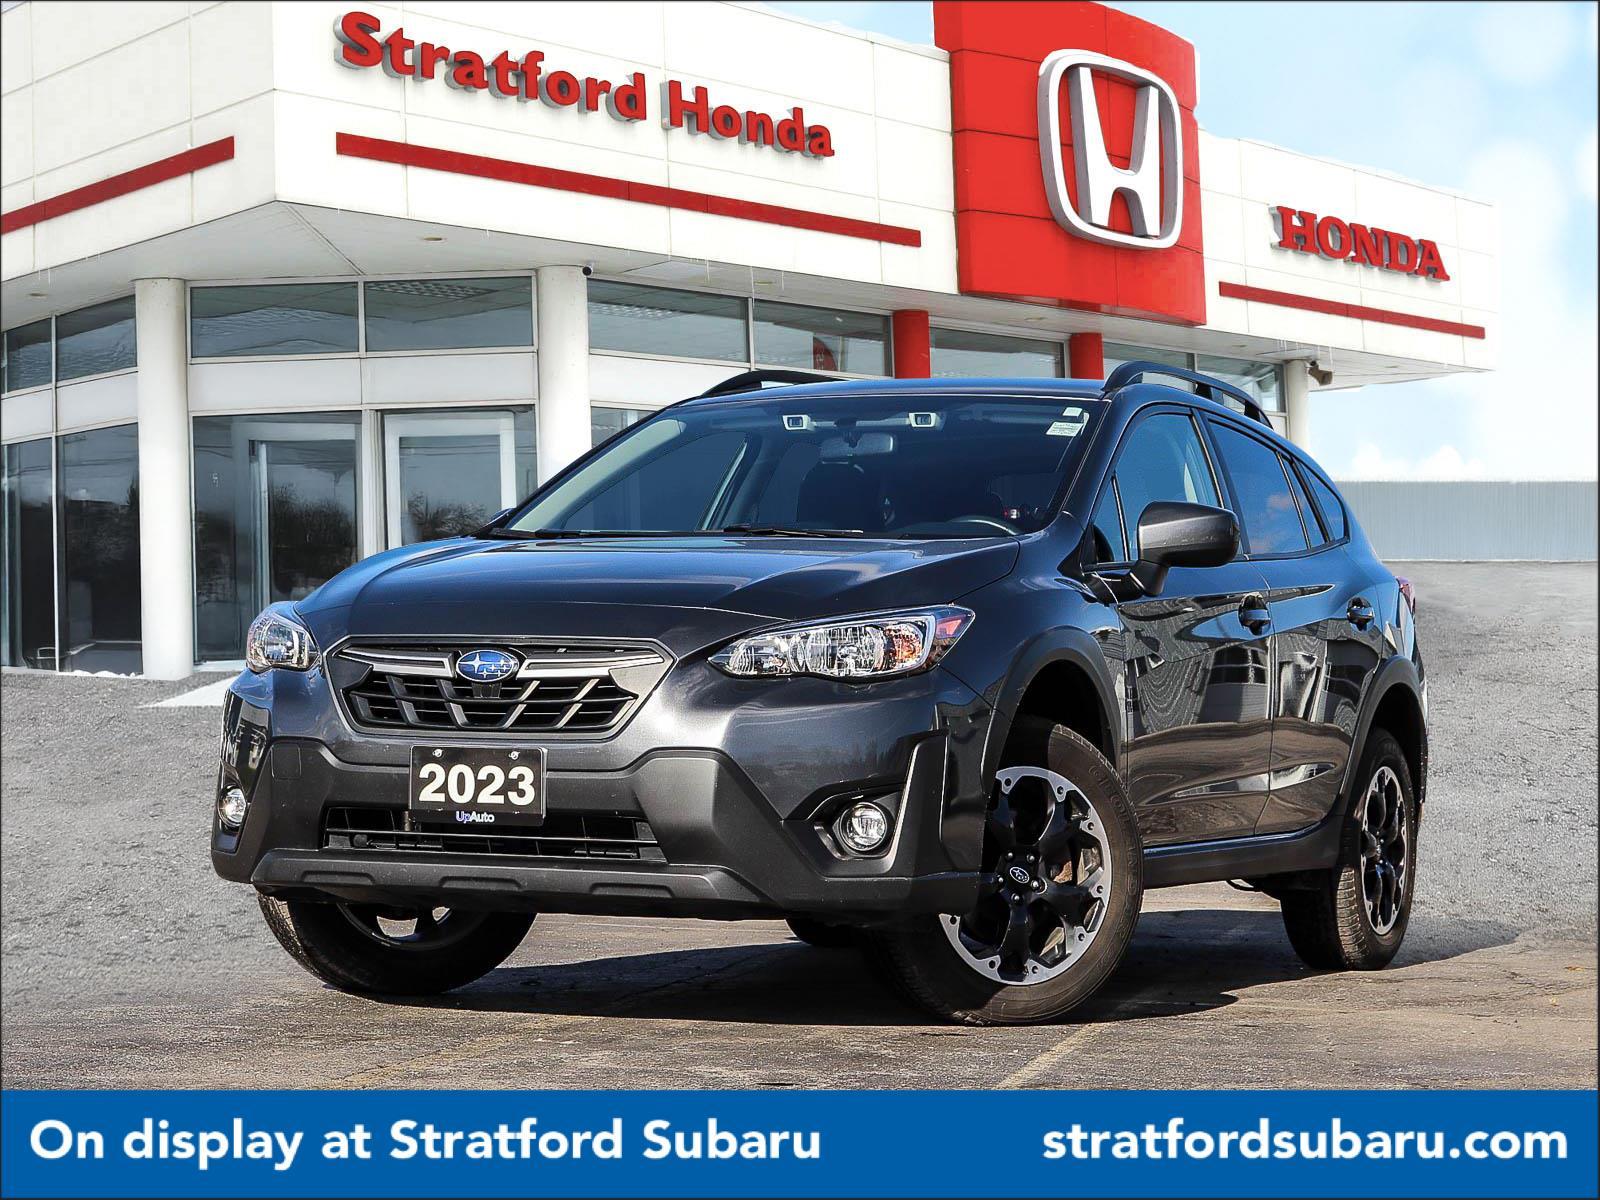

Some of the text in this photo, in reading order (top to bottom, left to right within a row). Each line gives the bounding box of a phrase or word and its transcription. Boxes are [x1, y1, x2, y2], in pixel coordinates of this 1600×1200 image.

[336, 11, 836, 158] Stratford Honda
[1275, 206, 1451, 282] HONDA
[418, 762, 536, 806] 2023
[455, 810, 495, 824] UpAuto
